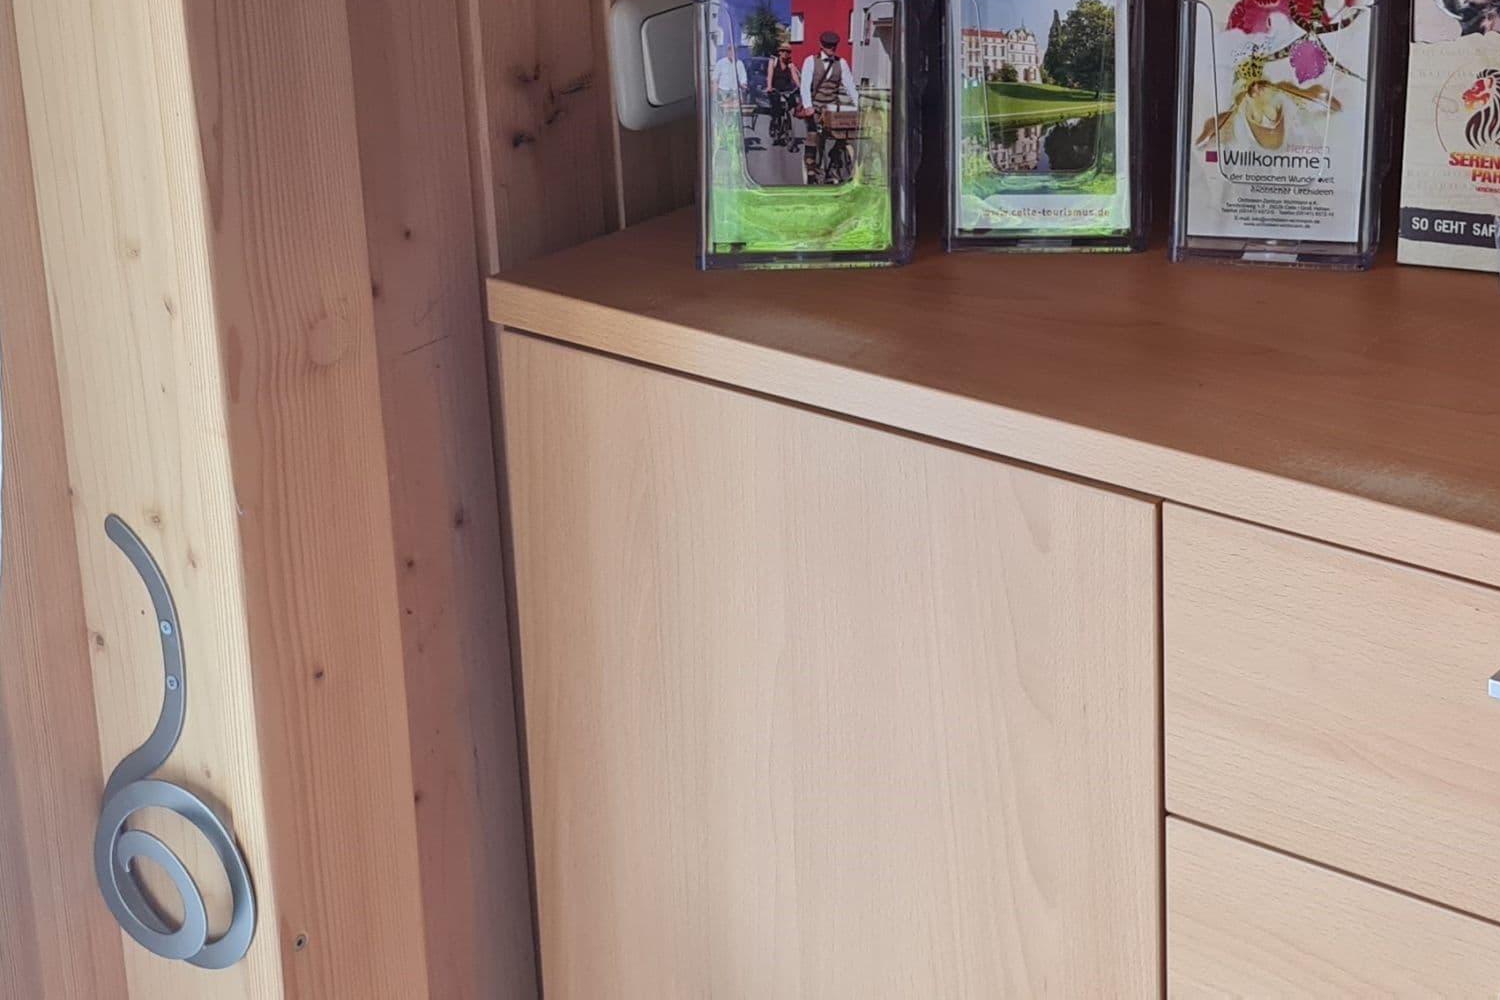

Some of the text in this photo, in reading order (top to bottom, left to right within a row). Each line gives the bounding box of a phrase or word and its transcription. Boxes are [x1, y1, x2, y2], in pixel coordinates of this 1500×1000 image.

[1223, 150, 1330, 168] Willkommen
[1412, 217, 1429, 231] SO
[1434, 219, 1466, 235] GEHT
